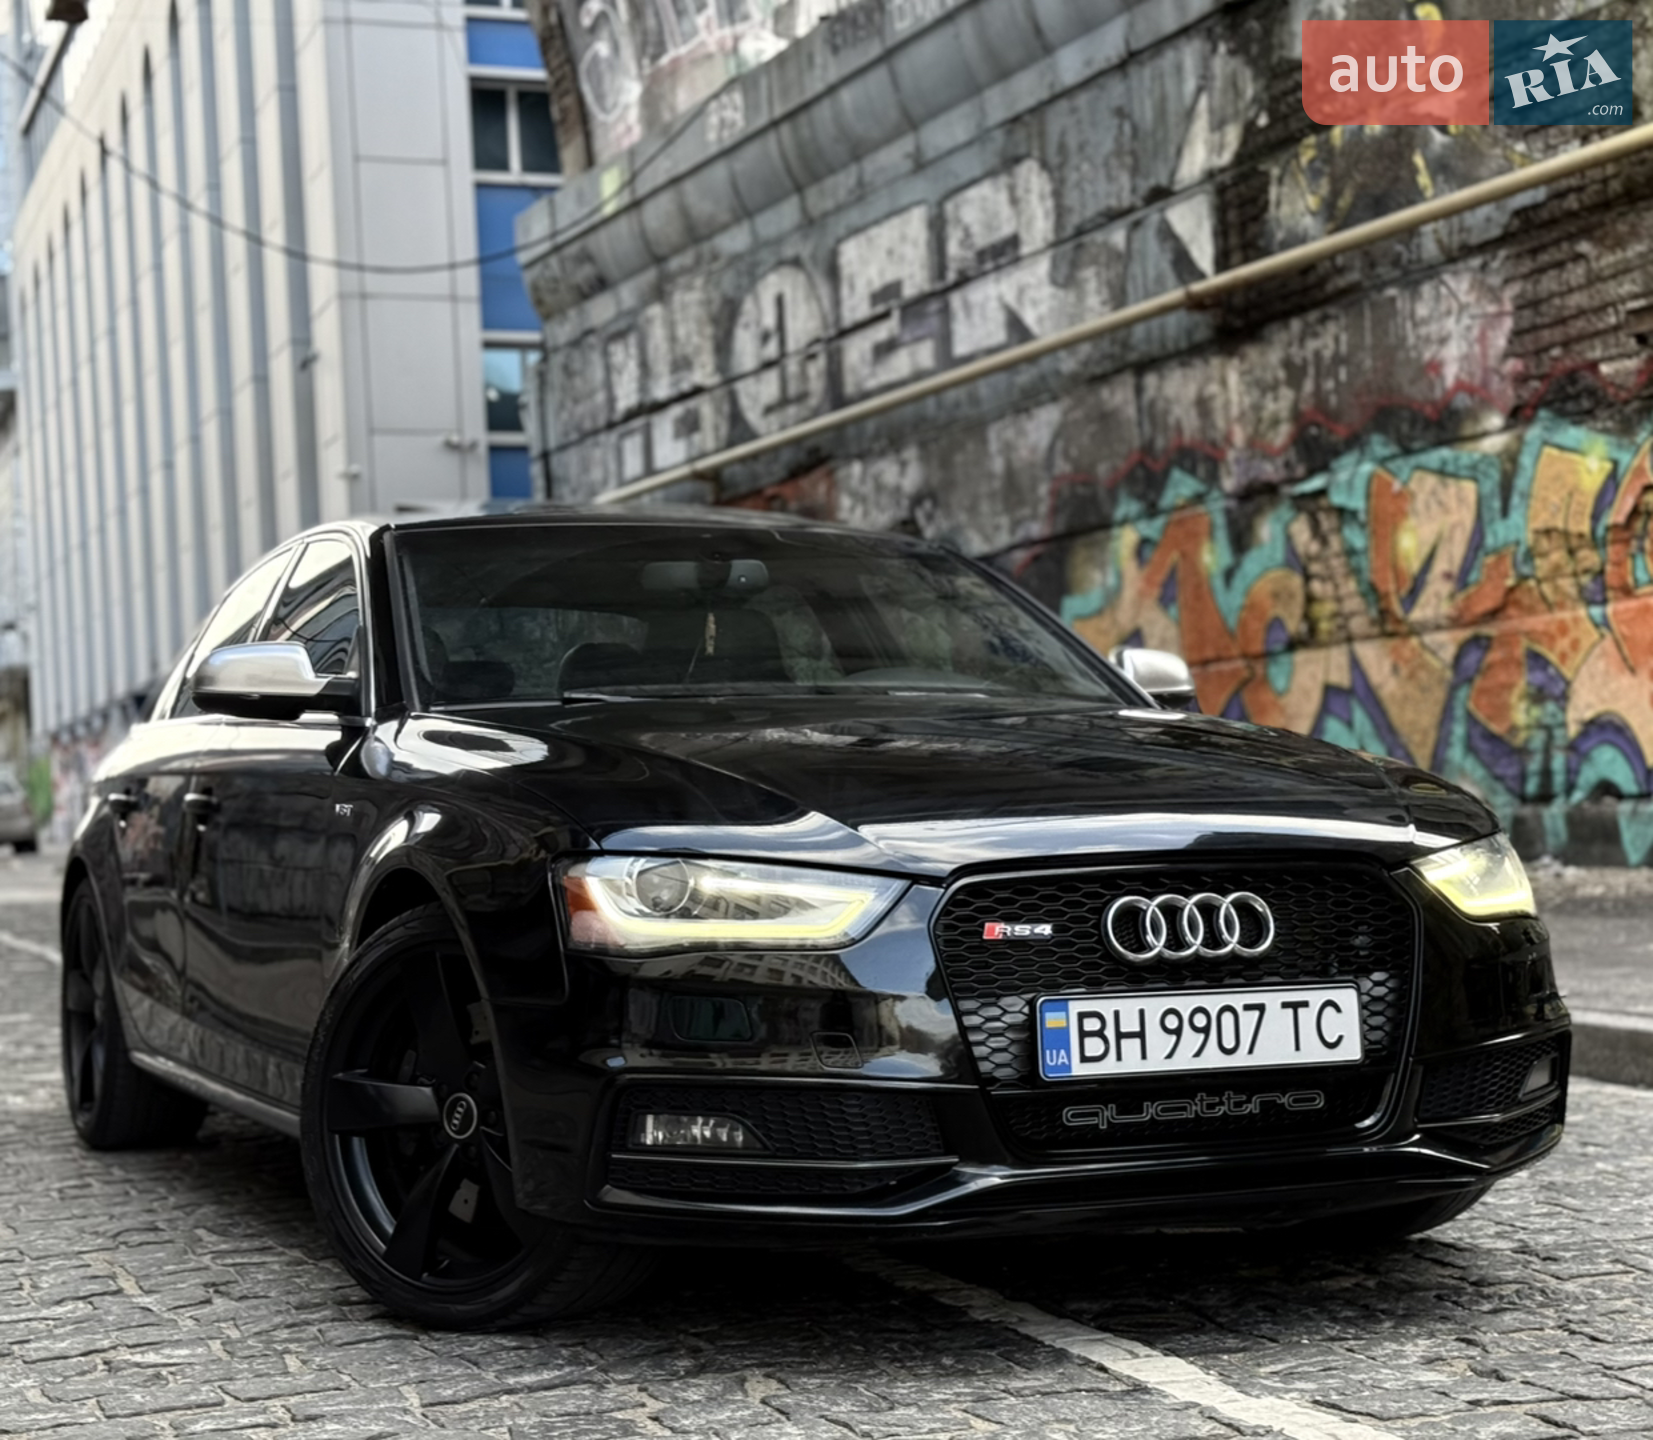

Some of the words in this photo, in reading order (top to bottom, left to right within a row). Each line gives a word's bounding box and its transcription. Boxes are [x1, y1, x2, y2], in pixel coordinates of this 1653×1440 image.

[984, 922, 1053, 940] RS4
[1077, 1007, 1148, 1064] BH
[1159, 1002, 1266, 1060] 9907
[1281, 999, 1344, 1052] TC
[1046, 1050, 1069, 1066] UA
[1062, 1090, 1326, 1129] quattro
